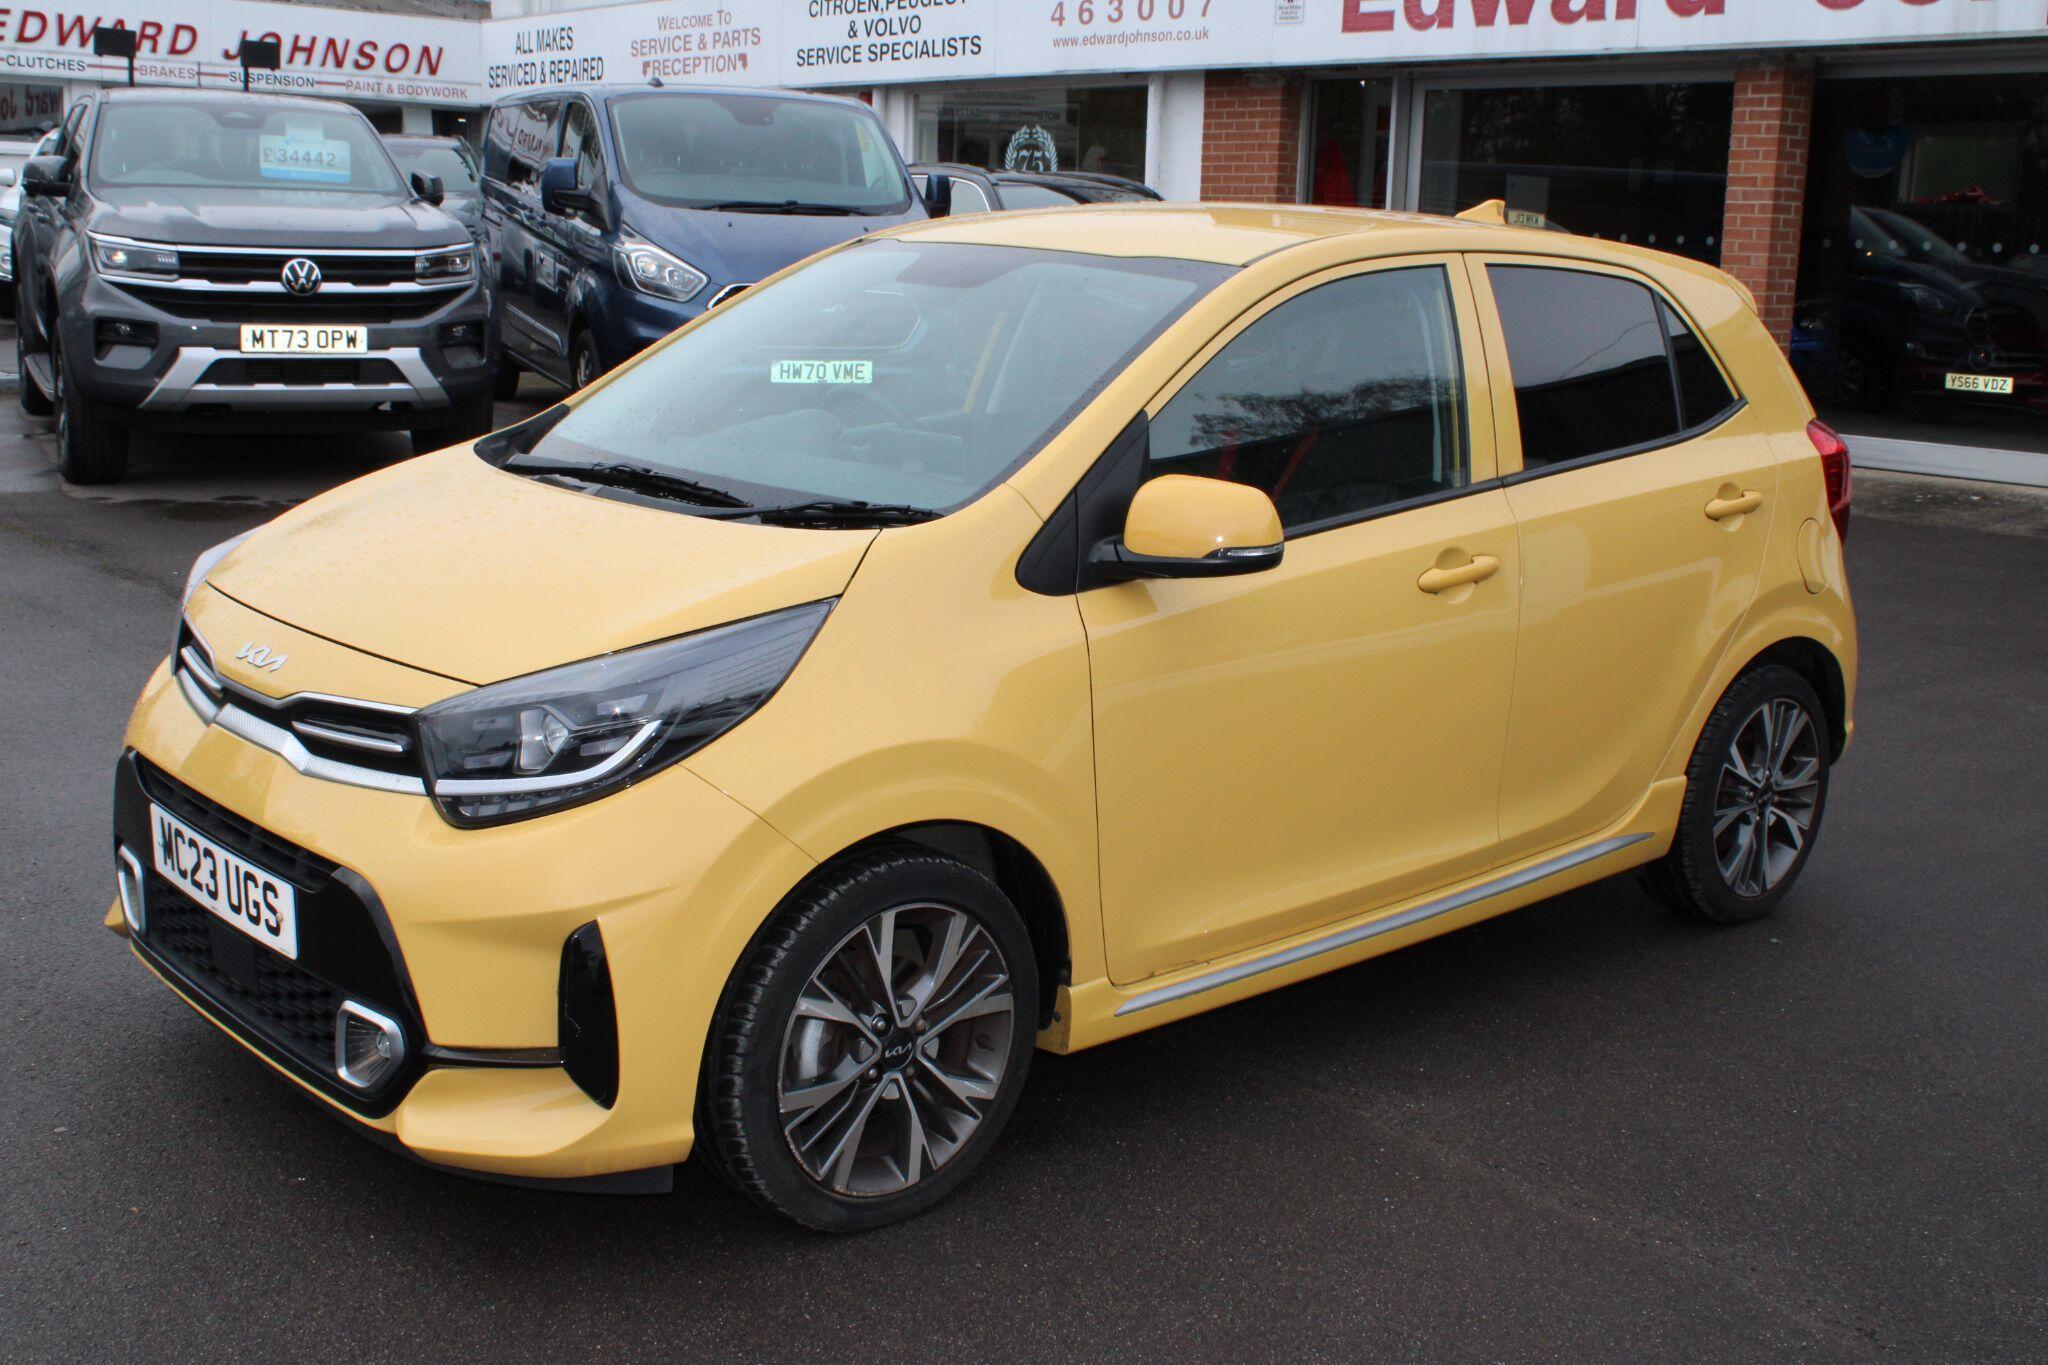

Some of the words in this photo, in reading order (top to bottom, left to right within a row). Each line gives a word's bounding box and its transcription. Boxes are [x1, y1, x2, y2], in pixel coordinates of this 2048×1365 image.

[515, 32, 534, 55] ALL
[536, 26, 574, 52] MAKES
[847, 20, 858, 39] &
[863, 15, 922, 38] VOLVO
[1052, 27, 1209, 48] www.edwardjohnson.co.uk
[0, 8, 198, 56] DWRD
[223, 30, 443, 76] JHNSON
[631, 34, 692, 58] SERVICE
[697, 33, 707, 50] &
[712, 27, 761, 49] PARTS
[796, 45, 862, 67] SERVICE
[867, 35, 982, 62] SPECIALISTS
[6, 54, 86, 72] CLUTCHES
[139, 65, 196, 80] BRAKES
[229, 71, 315, 88] SUSPENSION
[346, 80, 381, 94] PAINT
[386, 83, 394, 94] &
[397, 84, 468, 99] BODYWORK
[488, 61, 537, 88] SERVICED
[539, 62, 547, 84] &
[549, 56, 604, 83] REPAIRED
[651, 54, 738, 76] RECEPTION
[251, 329, 309, 349] MT73
[316, 330, 358, 348] OPW
[780, 363, 827, 380] HW70
[832, 363, 865, 380] VME
[1950, 375, 1979, 389] YS66
[1983, 378, 2008, 391] VDZ
[160, 816, 219, 901] MC23
[225, 858, 282, 937] UGS
